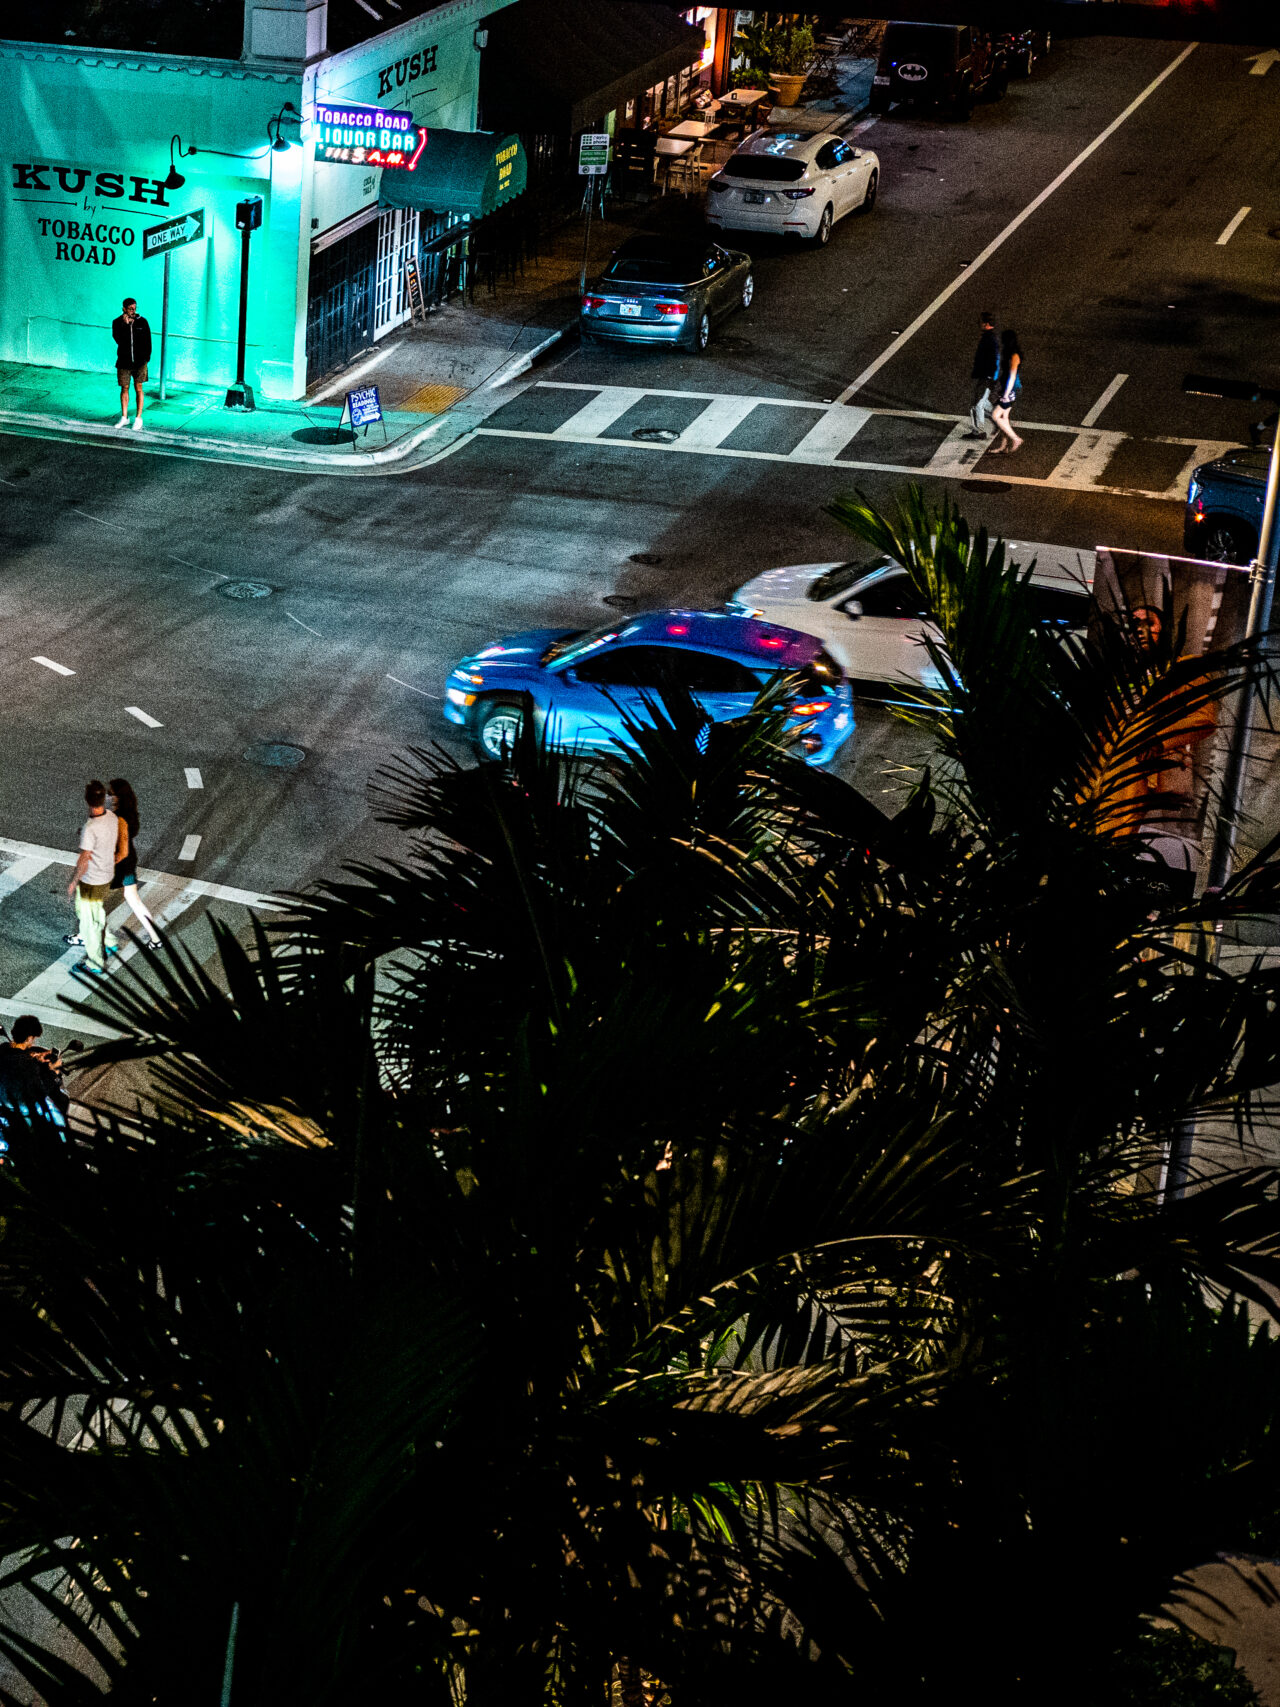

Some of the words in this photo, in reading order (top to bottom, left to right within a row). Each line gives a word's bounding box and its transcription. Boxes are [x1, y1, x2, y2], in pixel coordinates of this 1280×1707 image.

[377, 44, 439, 99] KUSH
[317, 107, 372, 127] TOBACCO
[375, 111, 409, 131] ROAD
[315, 123, 376, 148] LIQUOR
[380, 129, 415, 151] BAR
[12, 163, 170, 207] KUSH
[83, 195, 97, 219] by
[37, 217, 135, 247] TOBACCO
[151, 231, 168, 246] ONE
[170, 225, 186, 239] WAY
[55, 241, 116, 267] ROAD
[351, 387, 376, 403] PSYCHIC
